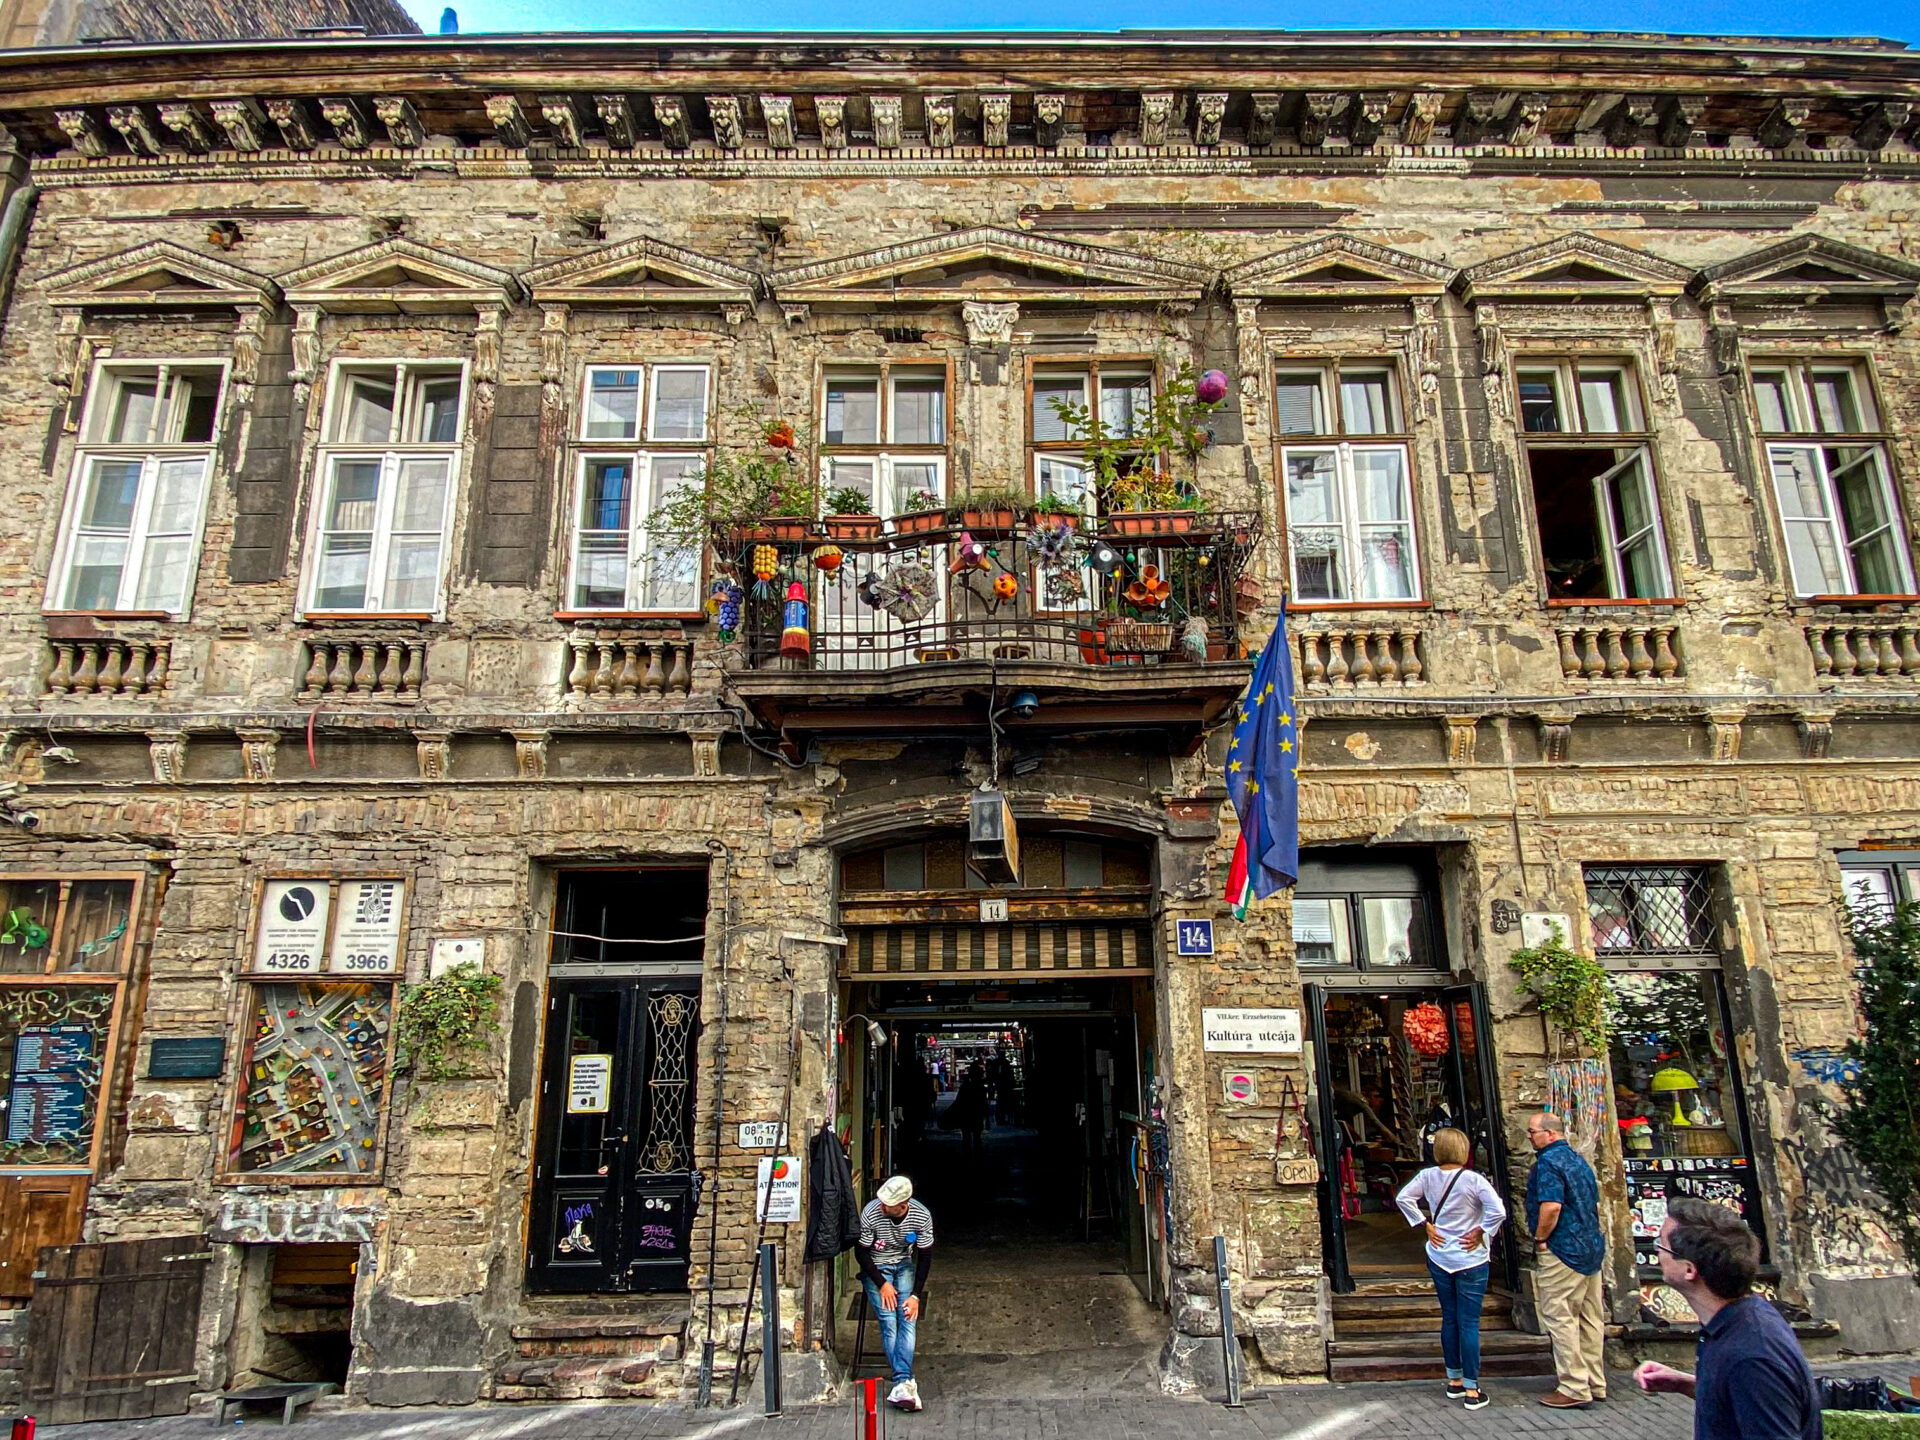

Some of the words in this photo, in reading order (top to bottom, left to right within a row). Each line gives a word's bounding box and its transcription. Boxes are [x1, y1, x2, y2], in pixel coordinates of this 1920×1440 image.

[989, 905, 1000, 918] 14
[1182, 927, 1208, 947] 14
[267, 954, 310, 969] 4326
[346, 955, 389, 970] 3966
[1207, 1031, 1252, 1041] Kultúra
[1259, 1030, 1295, 1044] utcája
[754, 1136, 763, 1145] 10
[759, 1181, 799, 1189] ATENTION!
